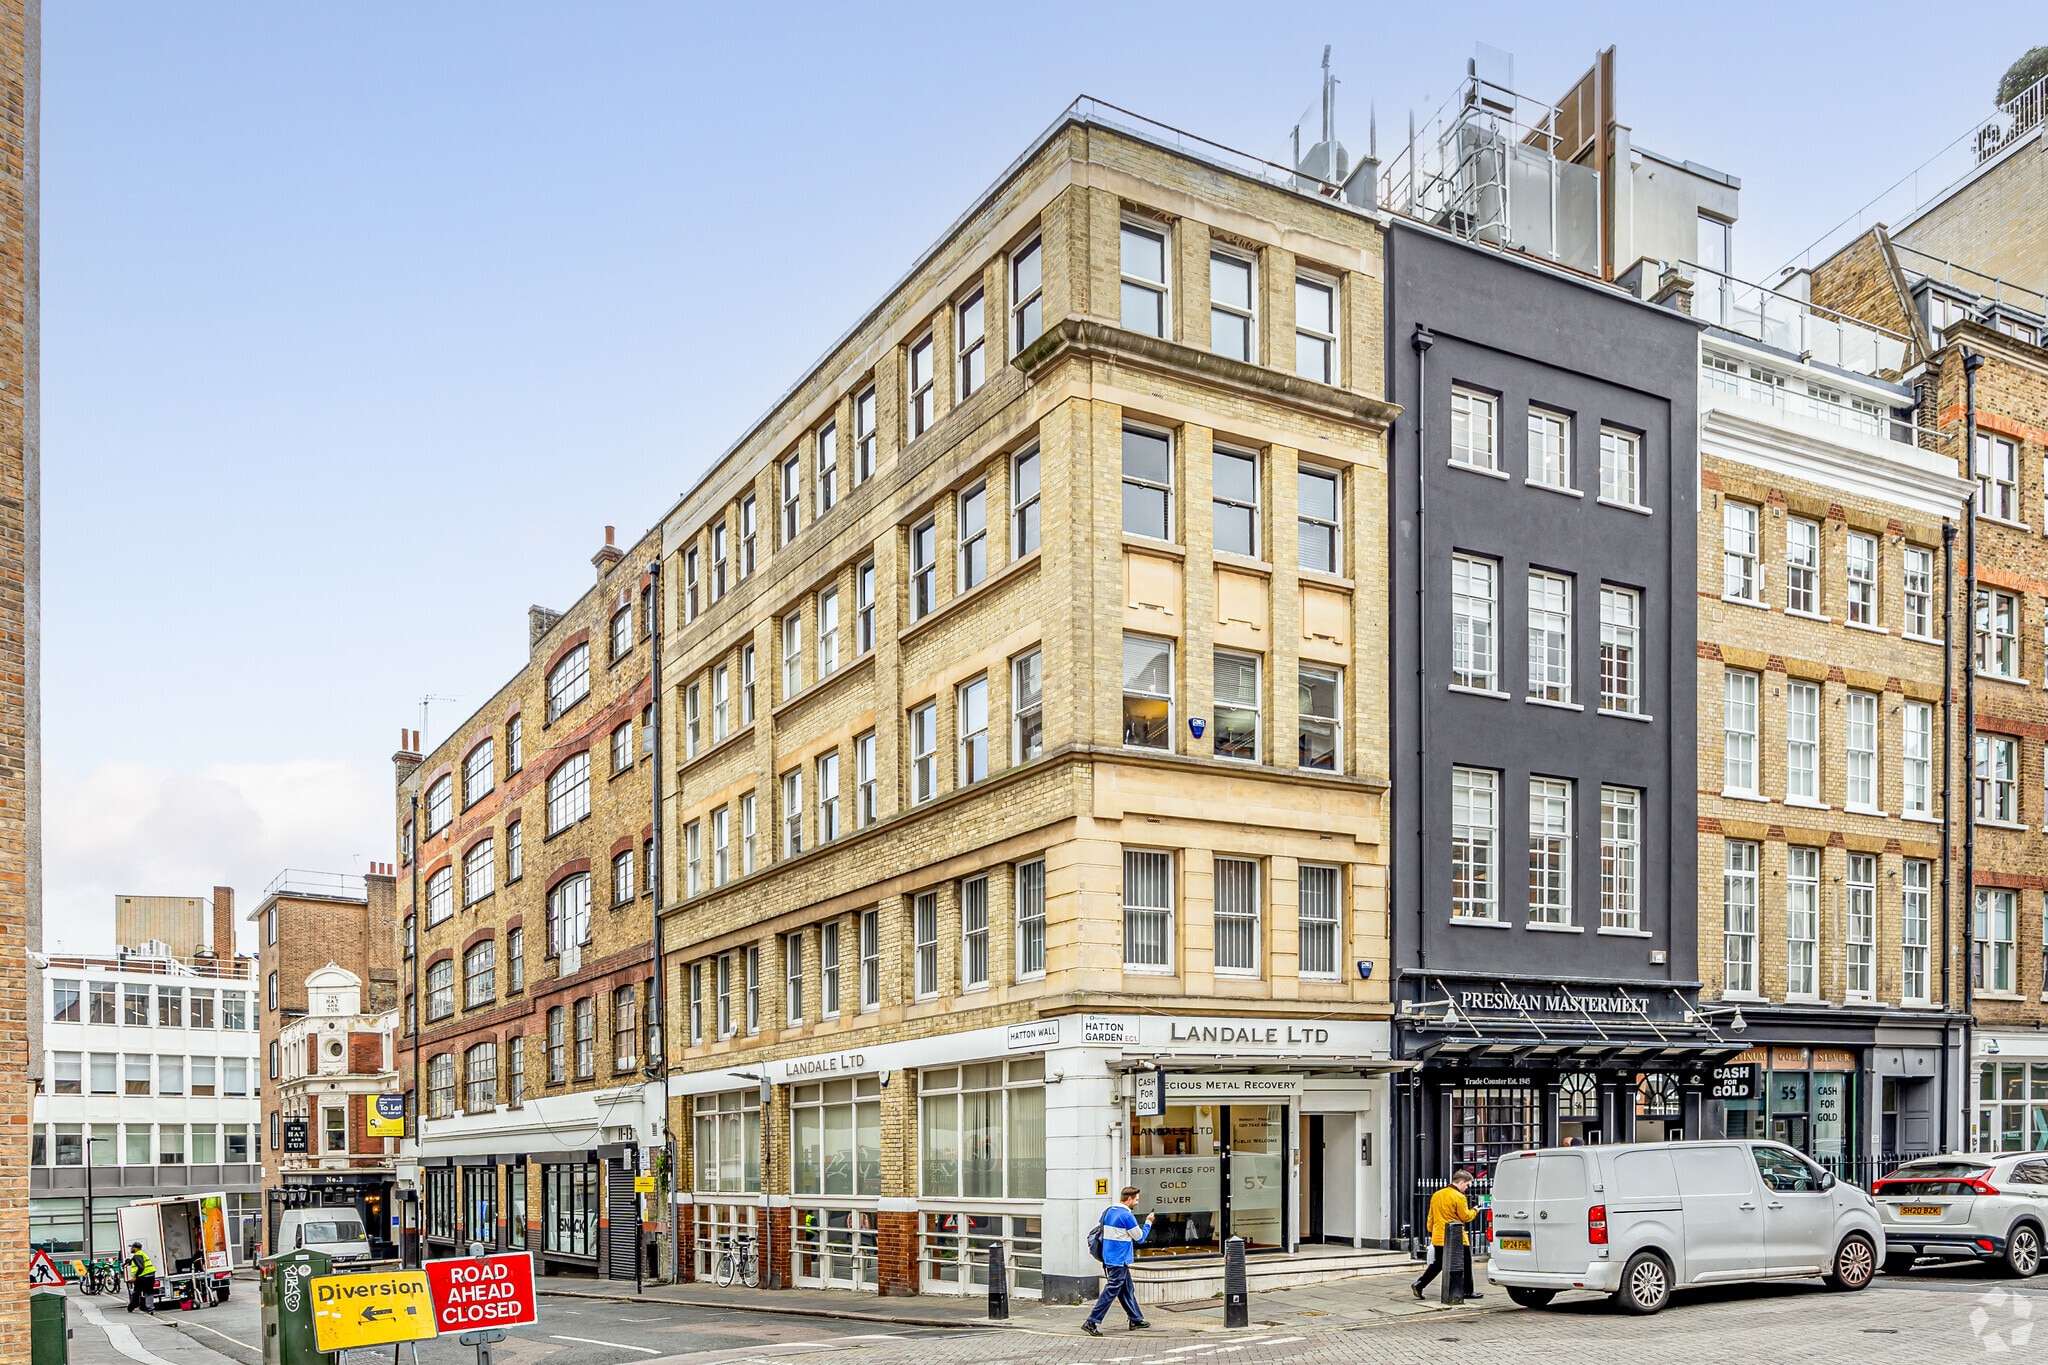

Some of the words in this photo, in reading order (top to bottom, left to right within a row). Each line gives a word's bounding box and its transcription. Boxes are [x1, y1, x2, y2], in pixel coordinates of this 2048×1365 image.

[1461, 991, 1542, 1012] PRESMAN
[1545, 995, 1650, 1014] MASTERMELT
[1085, 1022, 1124, 1032] HATTON
[1010, 1029, 1036, 1041] HATTON
[1038, 1026, 1056, 1036] WALL
[1085, 1032, 1123, 1042] GARDEN
[1171, 1022, 1278, 1043] LANDALE
[1287, 1025, 1329, 1043] LTD
[1733, 1052, 1766, 1061] ATINUM
[1778, 1053, 1803, 1061] GOLD
[1818, 1053, 1850, 1062] SILVER
[785, 1058, 837, 1077] LANDALE
[840, 1054, 865, 1069] LTD
[1713, 1066, 1750, 1079] CASH
[1138, 1078, 1156, 1087] CASH
[1206, 1081, 1240, 1089] METAL
[1244, 1081, 1297, 1089] RECOVERY
[1464, 1077, 1482, 1085] Trade
[1483, 1077, 1507, 1085] Counter
[1507, 1077, 1518, 1085] Est.
[1140, 1090, 1153, 1098] FOR
[1712, 1085, 1749, 1097] GOLD
[1781, 1086, 1797, 1100] 55
[1818, 1087, 1838, 1095] CASH
[1138, 1102, 1156, 1110] GOLD
[1820, 1100, 1835, 1108] FOR
[1818, 1113, 1838, 1122] GOLD
[618, 1127, 633, 1141] 11-13
[1191, 1126, 1213, 1135] LTD
[1131, 1167, 1156, 1175] BEST
[1160, 1181, 1187, 1189] GOLD
[1244, 1175, 1268, 1190] 57
[1156, 1196, 1191, 1204] SILVER
[559, 1218, 585, 1233] SNCK
[450, 1263, 508, 1285] ROAD
[317, 1279, 425, 1303] Diversion
[447, 1282, 515, 1305] AHEAD
[442, 1300, 522, 1325] CLOSED
